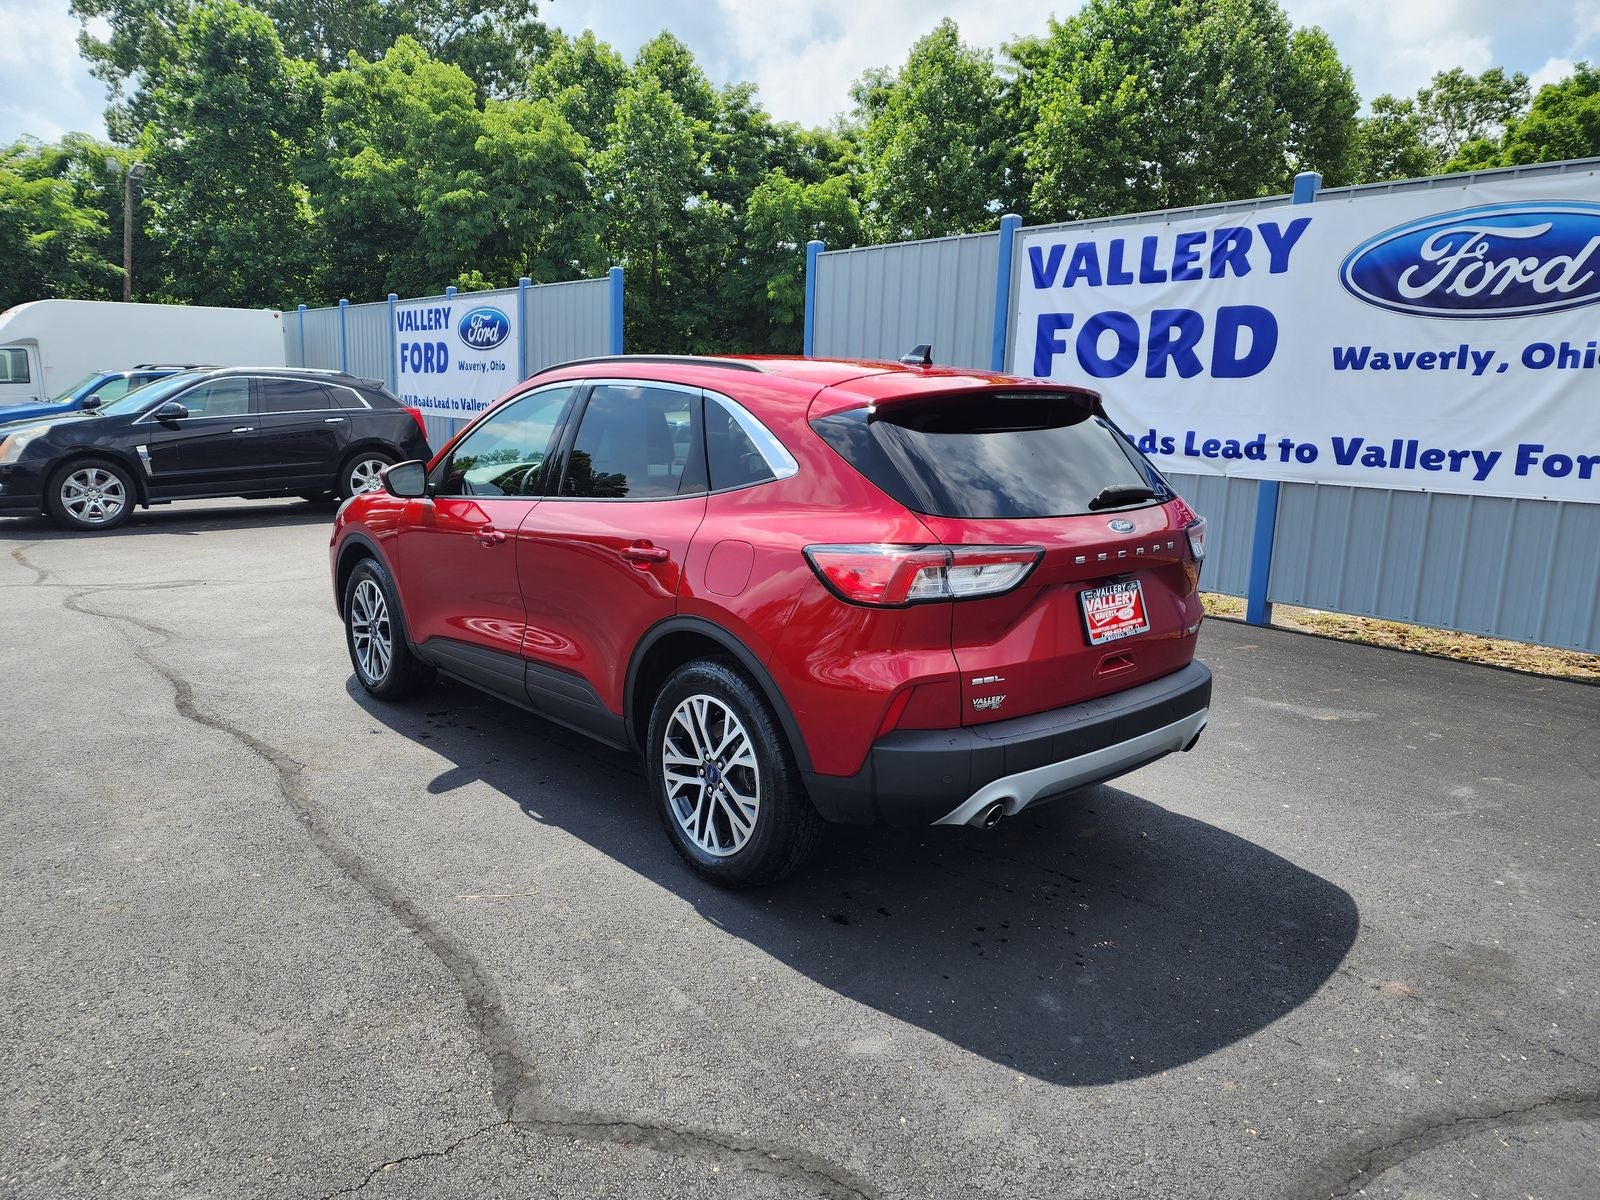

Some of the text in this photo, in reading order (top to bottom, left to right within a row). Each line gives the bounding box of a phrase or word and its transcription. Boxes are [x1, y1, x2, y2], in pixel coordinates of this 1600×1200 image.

[1028, 217, 1312, 290] VALLERY
[1398, 222, 1600, 299] Ford
[397, 306, 452, 332] VALLERY
[467, 313, 500, 342] Ford
[1033, 305, 1279, 379] FORD
[400, 341, 449, 374] FORD
[458, 360, 506, 373] Waverly, Ohio
[1332, 341, 1600, 376] Waverly, Ohi
[413, 395, 432, 408] Roads
[434, 396, 450, 410] Lead
[451, 399, 459, 410] to
[1184, 430, 1267, 461] Lead
[1277, 438, 1319, 464] to
[1331, 437, 1503, 481] Vallery
[1514, 443, 1600, 479] For
[1075, 541, 1174, 564] ESCAPE
[1085, 589, 1138, 612] VALLERY
[1096, 583, 1126, 597] VALLERY
[972, 694, 1006, 705] VALLERY
